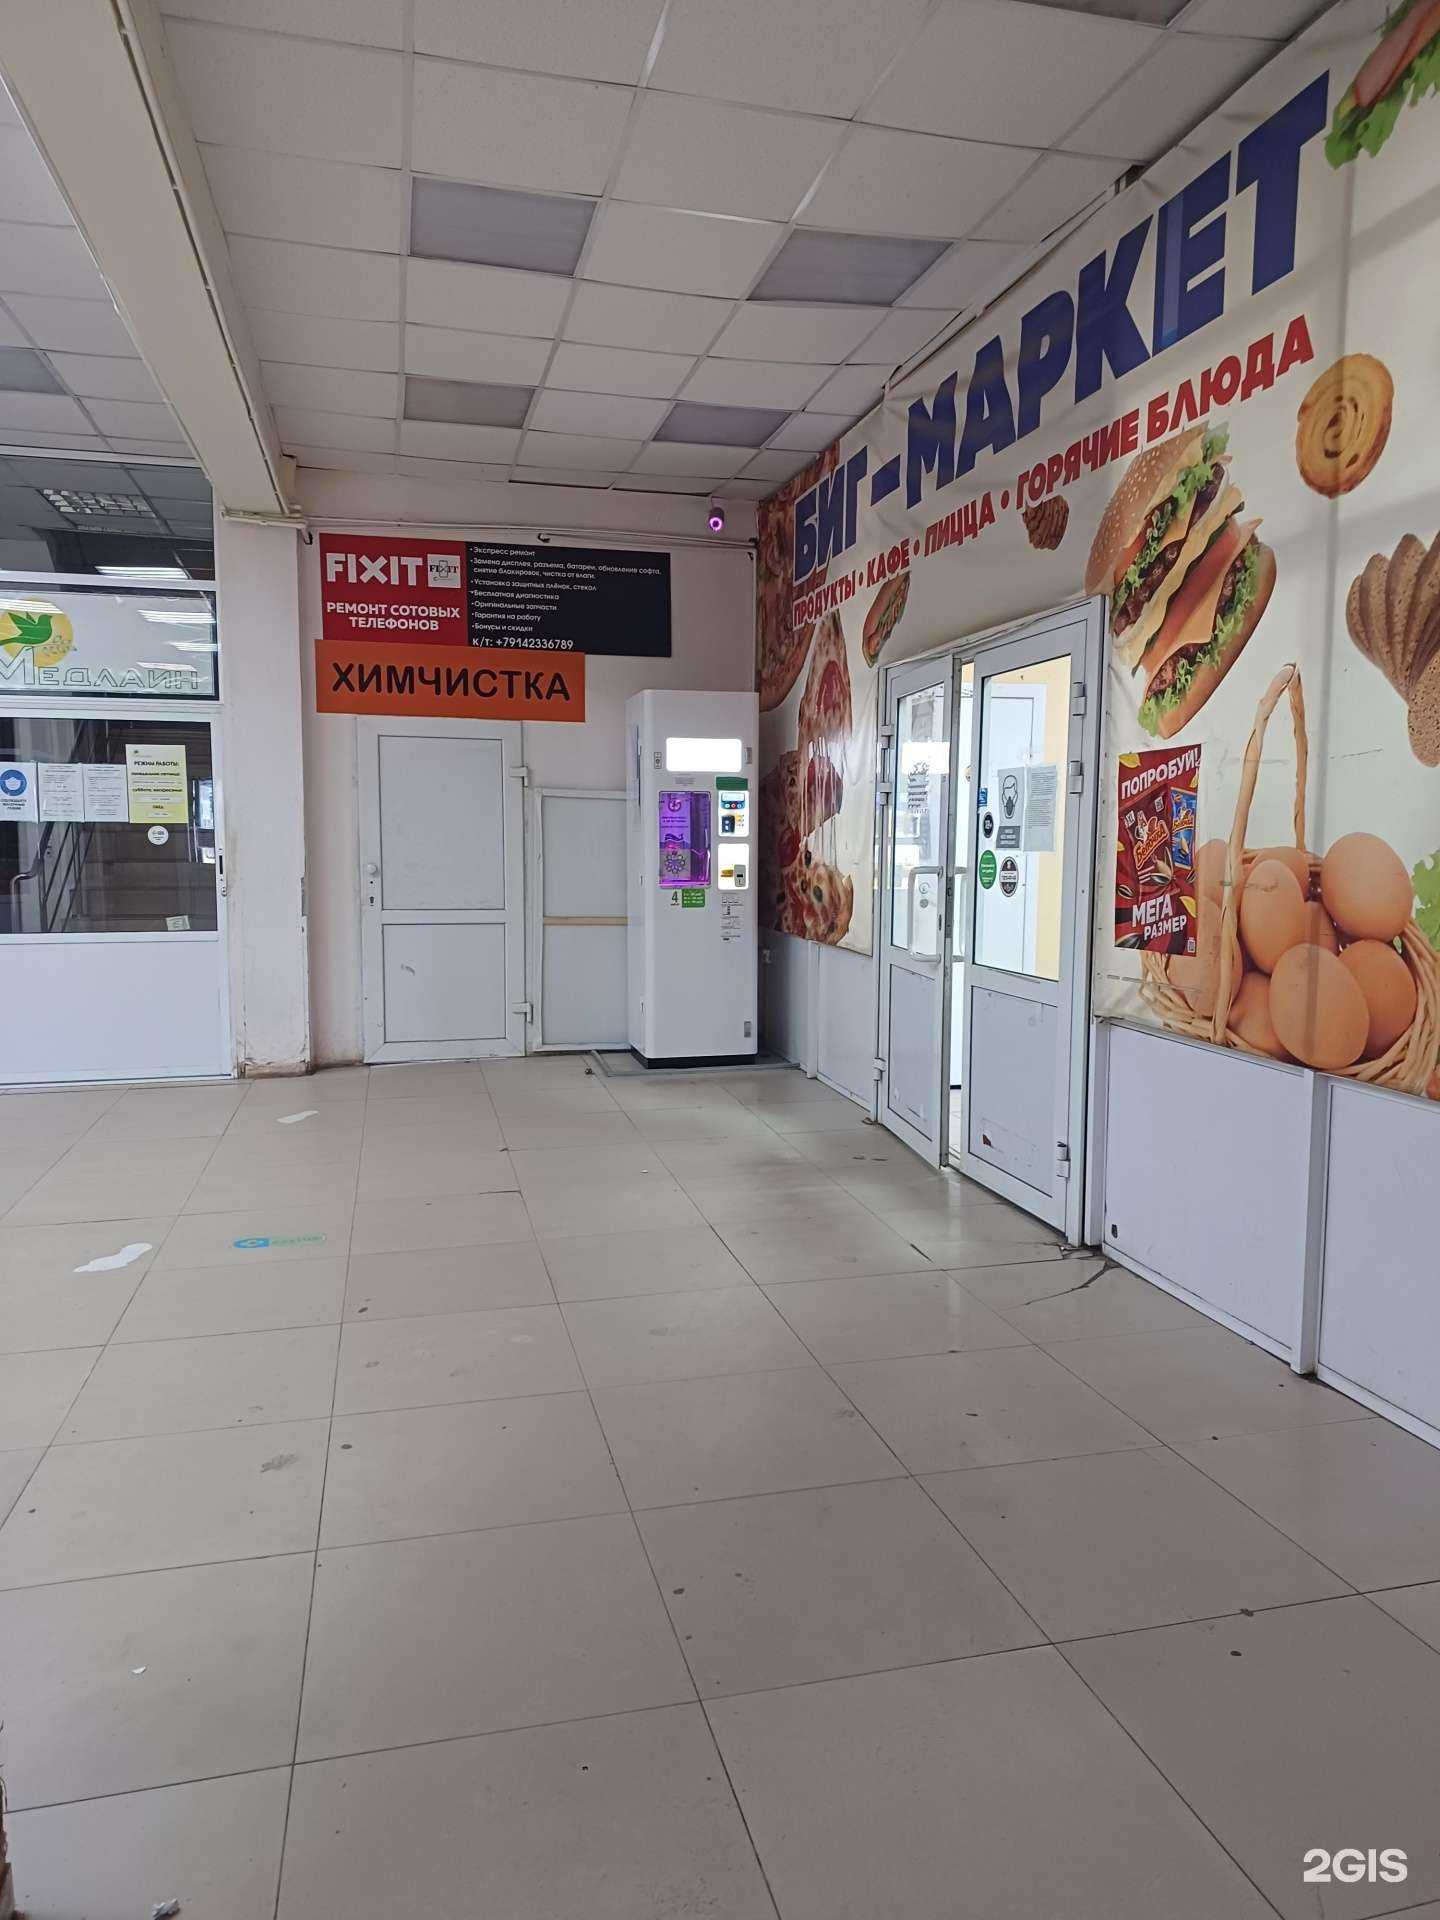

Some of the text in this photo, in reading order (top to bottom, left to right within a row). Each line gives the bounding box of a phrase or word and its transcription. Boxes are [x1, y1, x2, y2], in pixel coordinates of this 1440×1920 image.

[793, 69, 1330, 583] БИГ-МАРКЕТ
[793, 314, 1315, 627] ПРОДУКТЫ КАФЕ ПИЦЦА ГОРЯЧИЕ БЛЮДА
[474, 546, 536, 557] Экспресс ремонт
[326, 552, 423, 586] FIXIT
[473, 557, 501, 566] Замена
[474, 579, 511, 587] Установка
[474, 589, 560, 601] Бесплатная диагностика
[326, 601, 461, 619] РЕМОНТ СОТОВЫХ
[474, 600, 558, 611] Оригинальные запчасти
[348, 616, 440, 631] ТЕЛЕФОНОВ
[474, 611, 506, 620] Гарантия
[516, 613, 541, 622] работу
[474, 622, 501, 632] Бонусы
[507, 625, 534, 633] скидки
[495, 636, 574, 650] +79142336789
[332, 661, 571, 701] ХИМЧИСТКА
[1121, 747, 1201, 800] ПОПРОБУЙ!
[1131, 893, 1173, 928] МЕГА
[1143, 914, 1188, 941] РАЗМЕР
